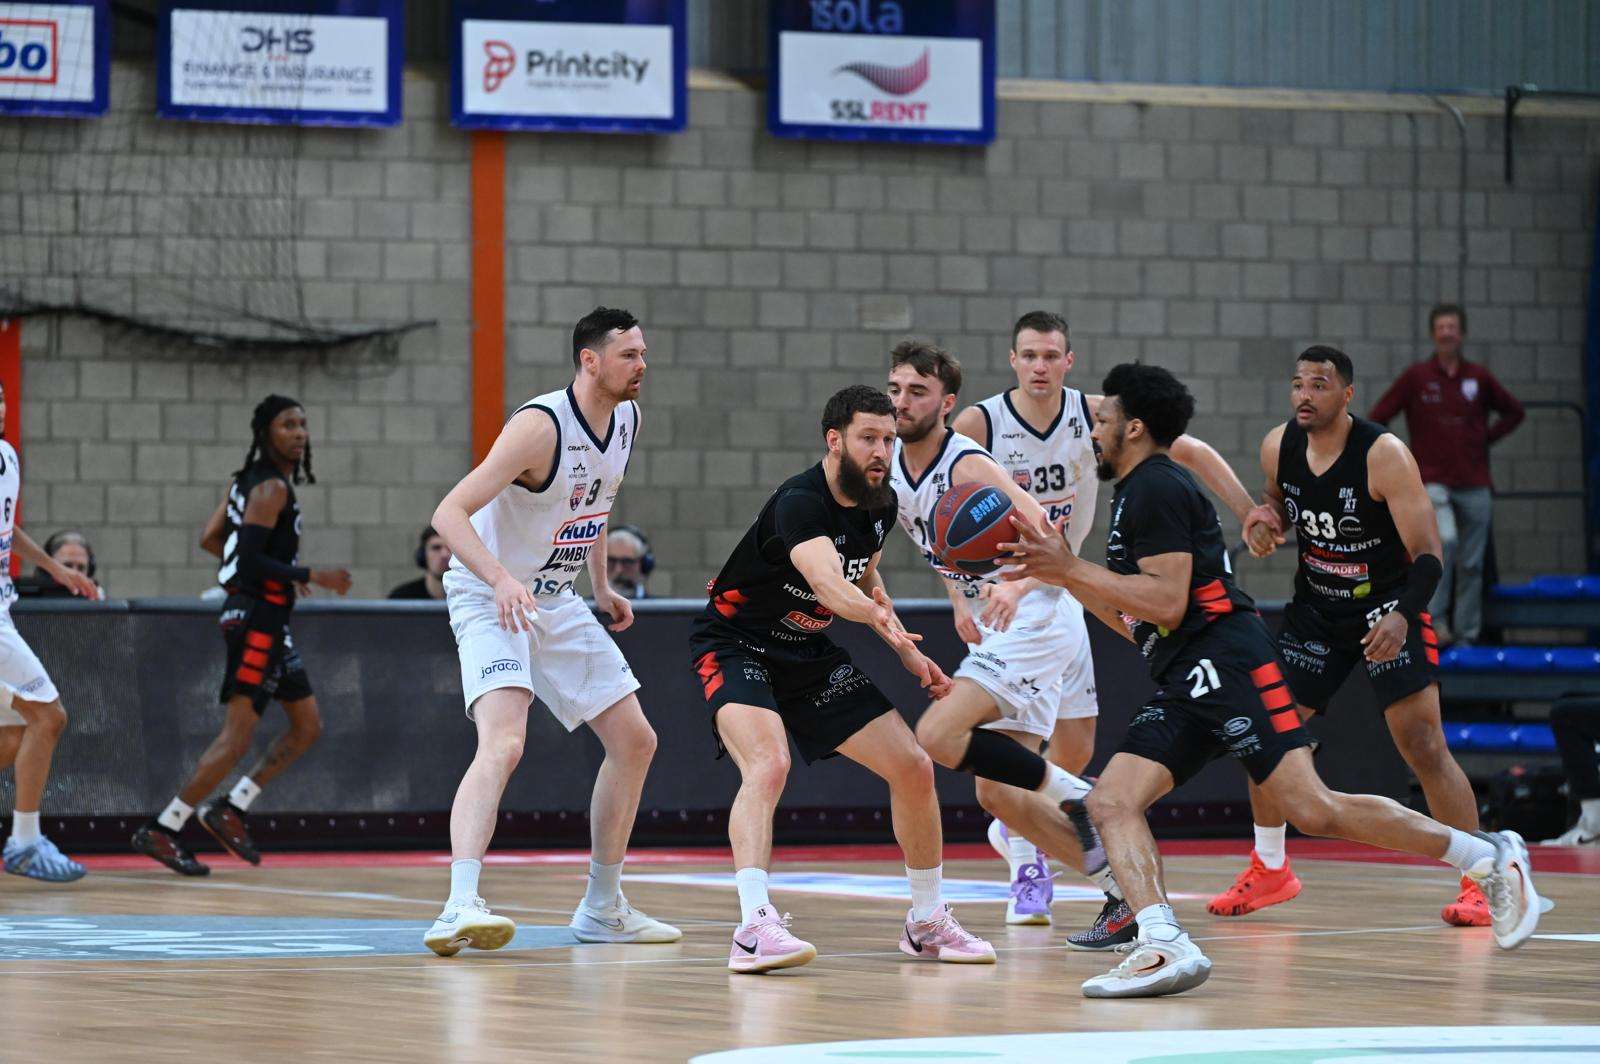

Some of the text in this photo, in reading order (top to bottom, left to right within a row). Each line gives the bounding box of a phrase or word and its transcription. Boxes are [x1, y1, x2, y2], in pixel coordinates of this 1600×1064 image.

[183, 61, 257, 81] FINANCE
[275, 64, 375, 83] INSURANCE
[525, 50, 649, 84] Printcity
[585, 478, 602, 506] 9
[1034, 464, 1066, 494] 33
[1301, 509, 1337, 540] 33
[1328, 538, 1382, 553] TALENTS
[845, 557, 869, 582] 55
[481, 658, 522, 679] jaraco
[1185, 658, 1222, 699] 21
